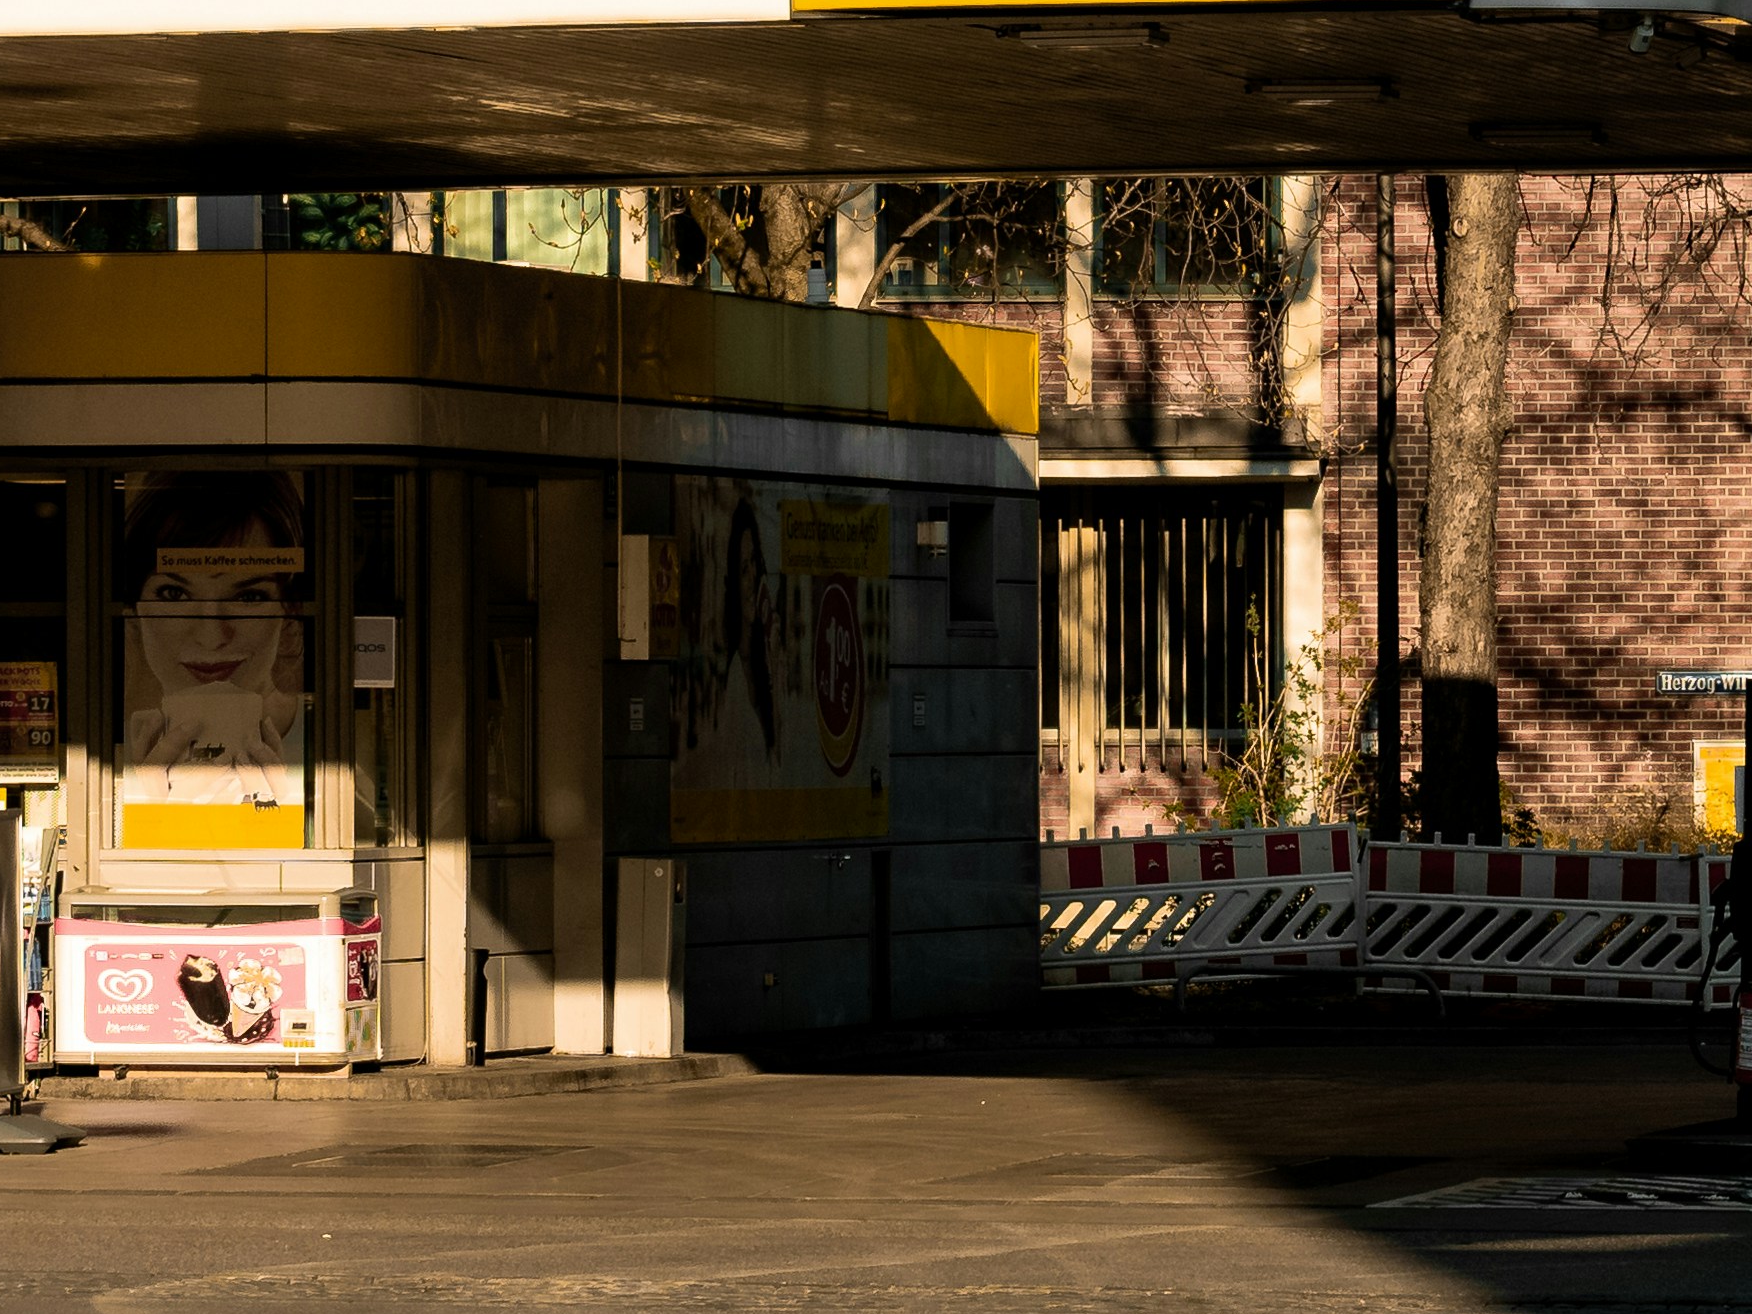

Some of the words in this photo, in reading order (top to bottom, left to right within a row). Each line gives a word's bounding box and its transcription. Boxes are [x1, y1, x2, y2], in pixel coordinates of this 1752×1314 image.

[162, 555, 175, 567] So
[176, 557, 203, 567] muss
[204, 555, 237, 568] Kaffee
[238, 555, 298, 568] schmecken.
[1660, 674, 1747, 695] Herzog-Wil
[30, 696, 51, 711] 17
[30, 730, 52, 746] 90
[97, 1004, 150, 1015] LANGNESE
